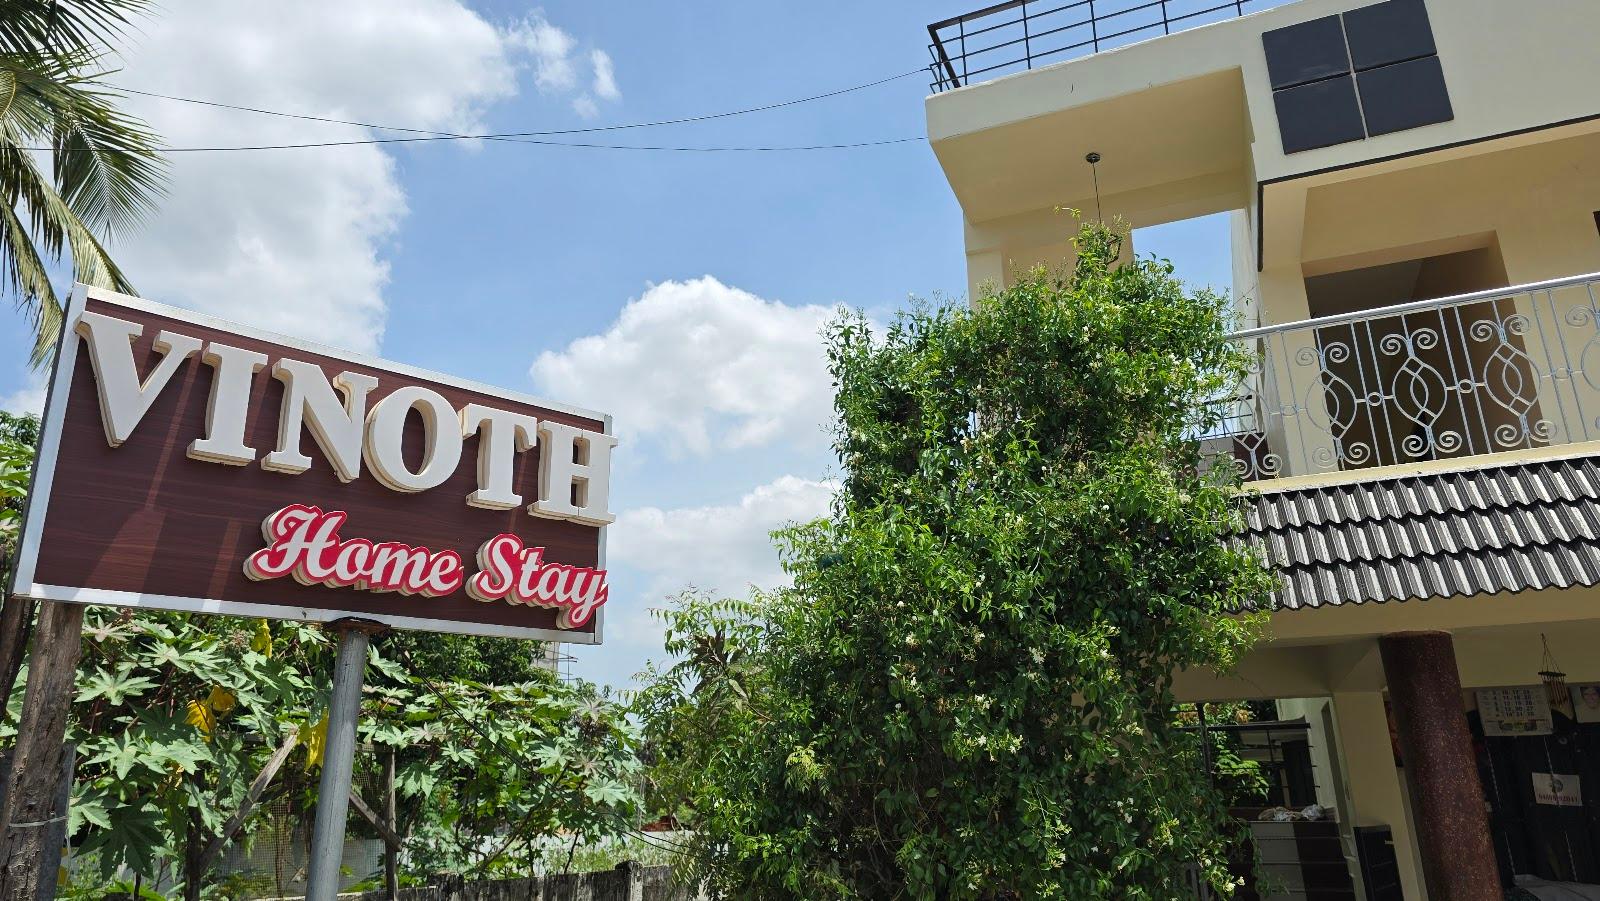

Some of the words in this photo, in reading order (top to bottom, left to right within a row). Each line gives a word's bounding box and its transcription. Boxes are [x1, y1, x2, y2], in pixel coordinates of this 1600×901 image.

[75, 311, 618, 526] VINOTH
[244, 503, 464, 598] Home
[465, 533, 609, 629] Stay
